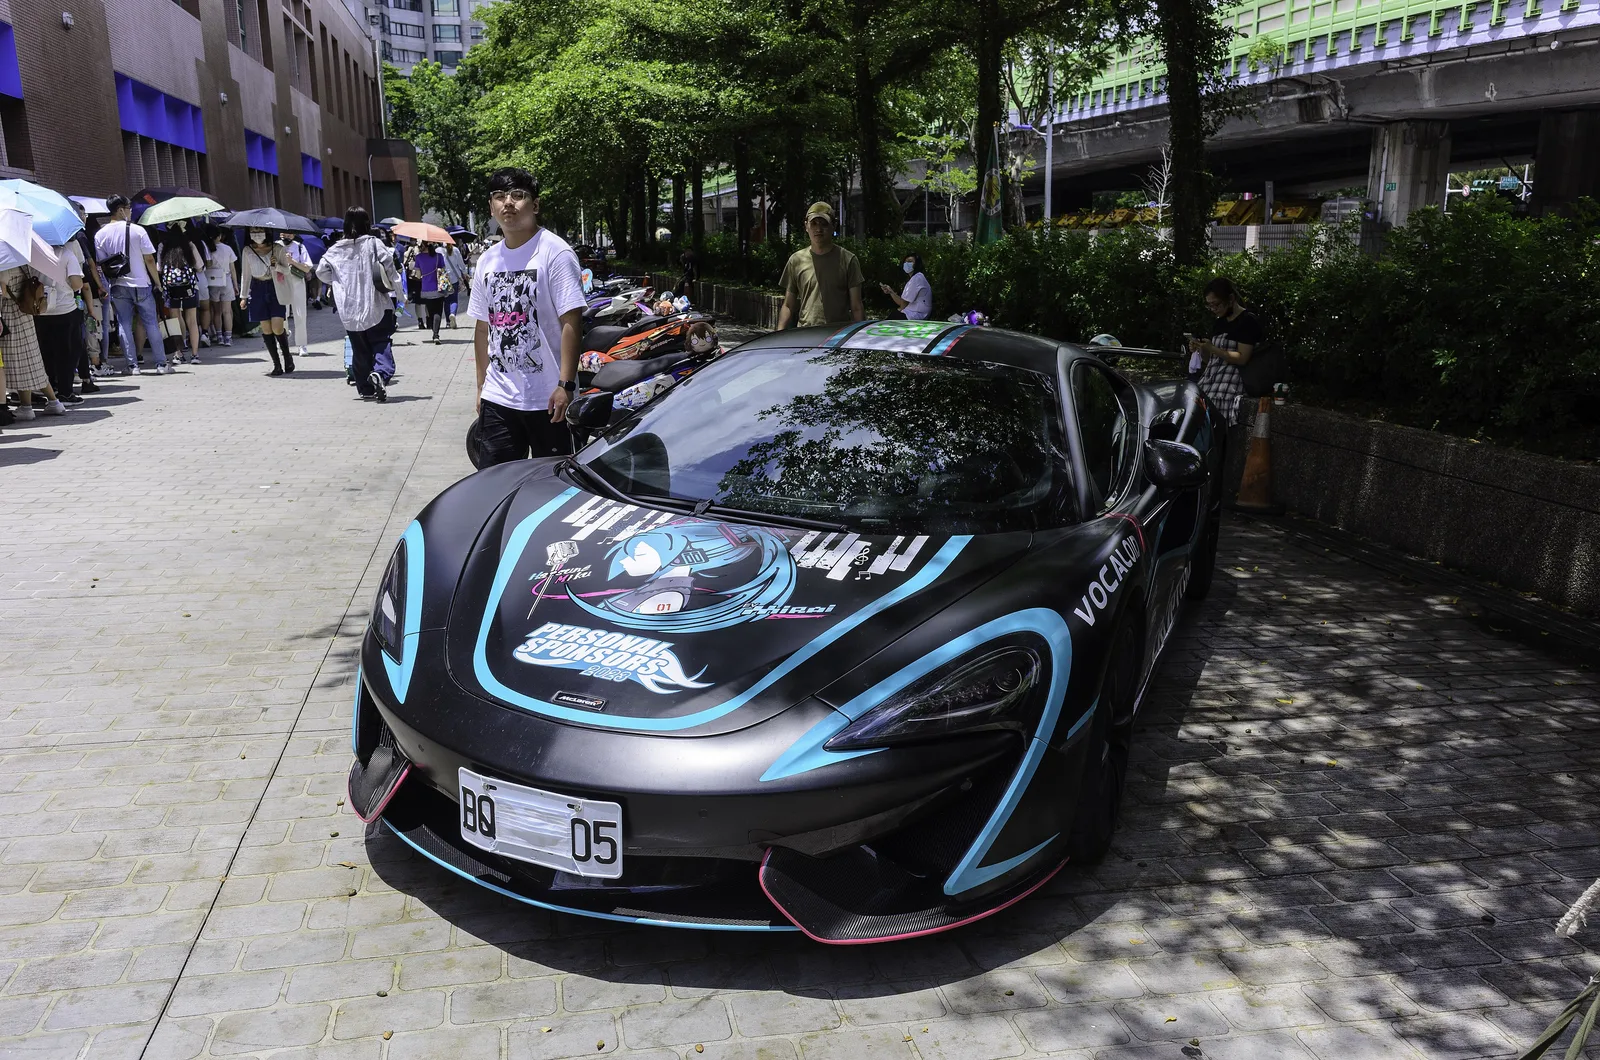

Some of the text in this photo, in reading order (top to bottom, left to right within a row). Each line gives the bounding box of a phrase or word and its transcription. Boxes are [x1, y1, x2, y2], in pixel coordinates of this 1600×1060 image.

[657, 603, 671, 612] 01
[526, 622, 675, 658] PERSONAL
[518, 638, 669, 675] SPONSORS
[579, 665, 631, 682] 2023
[558, 695, 596, 706] McLaren
[571, 817, 618, 865] 05
